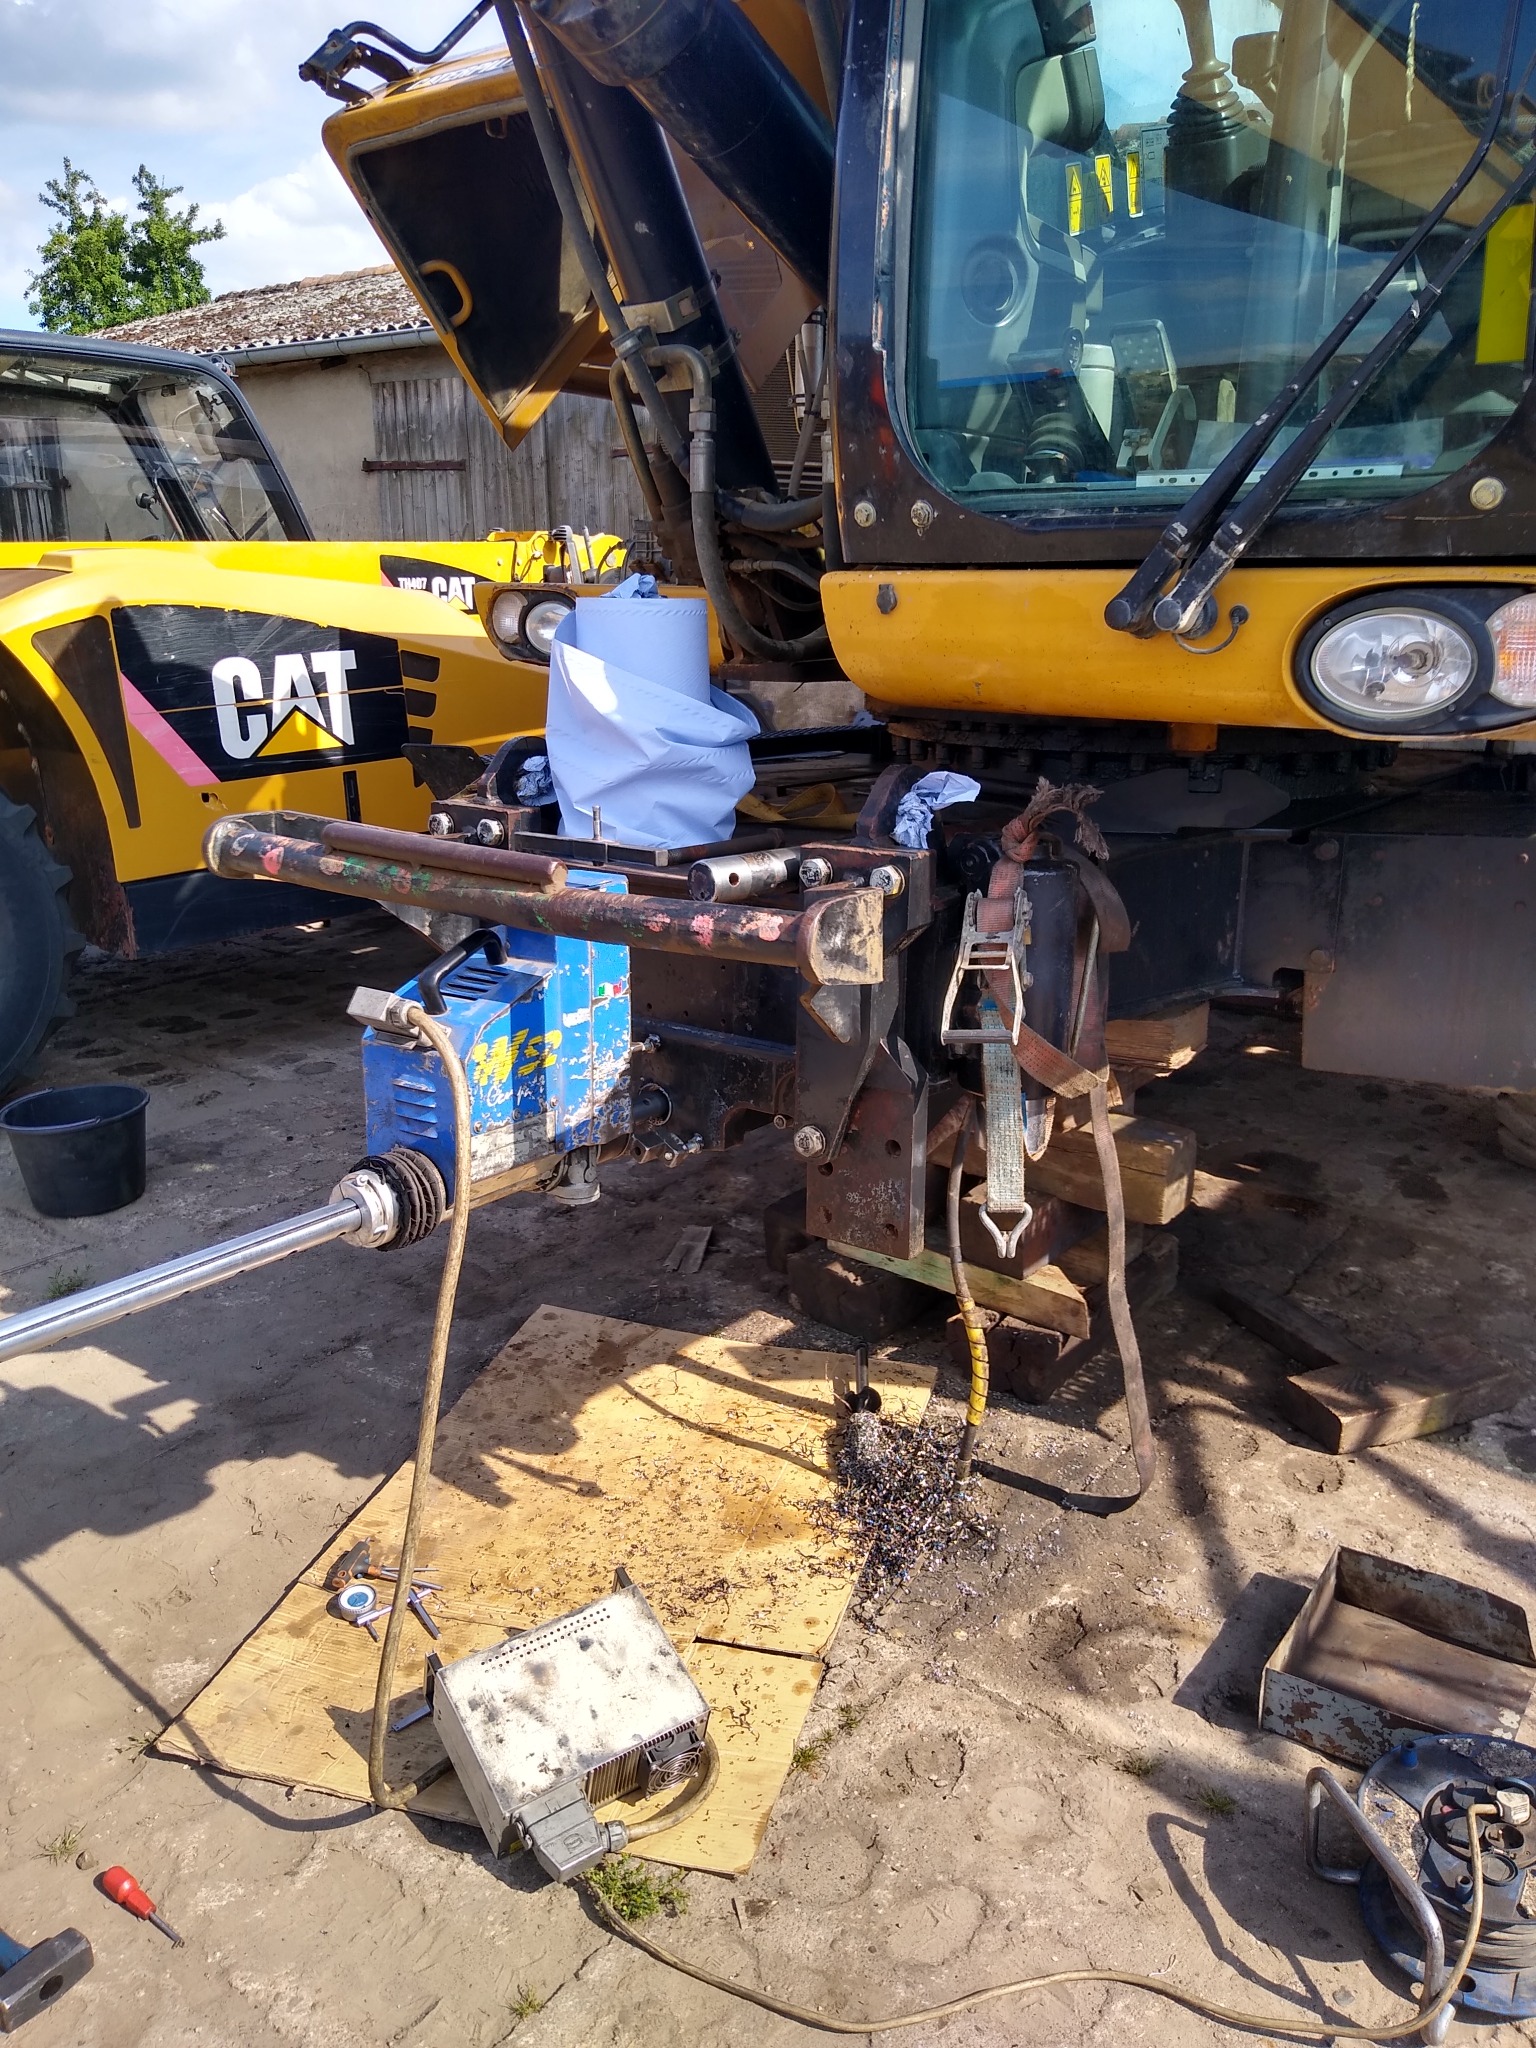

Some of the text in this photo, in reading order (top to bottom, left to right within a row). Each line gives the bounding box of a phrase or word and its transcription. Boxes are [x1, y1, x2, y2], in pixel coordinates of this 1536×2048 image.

[397, 576, 476, 611] TH407 CAT
[211, 649, 358, 760] CAT
